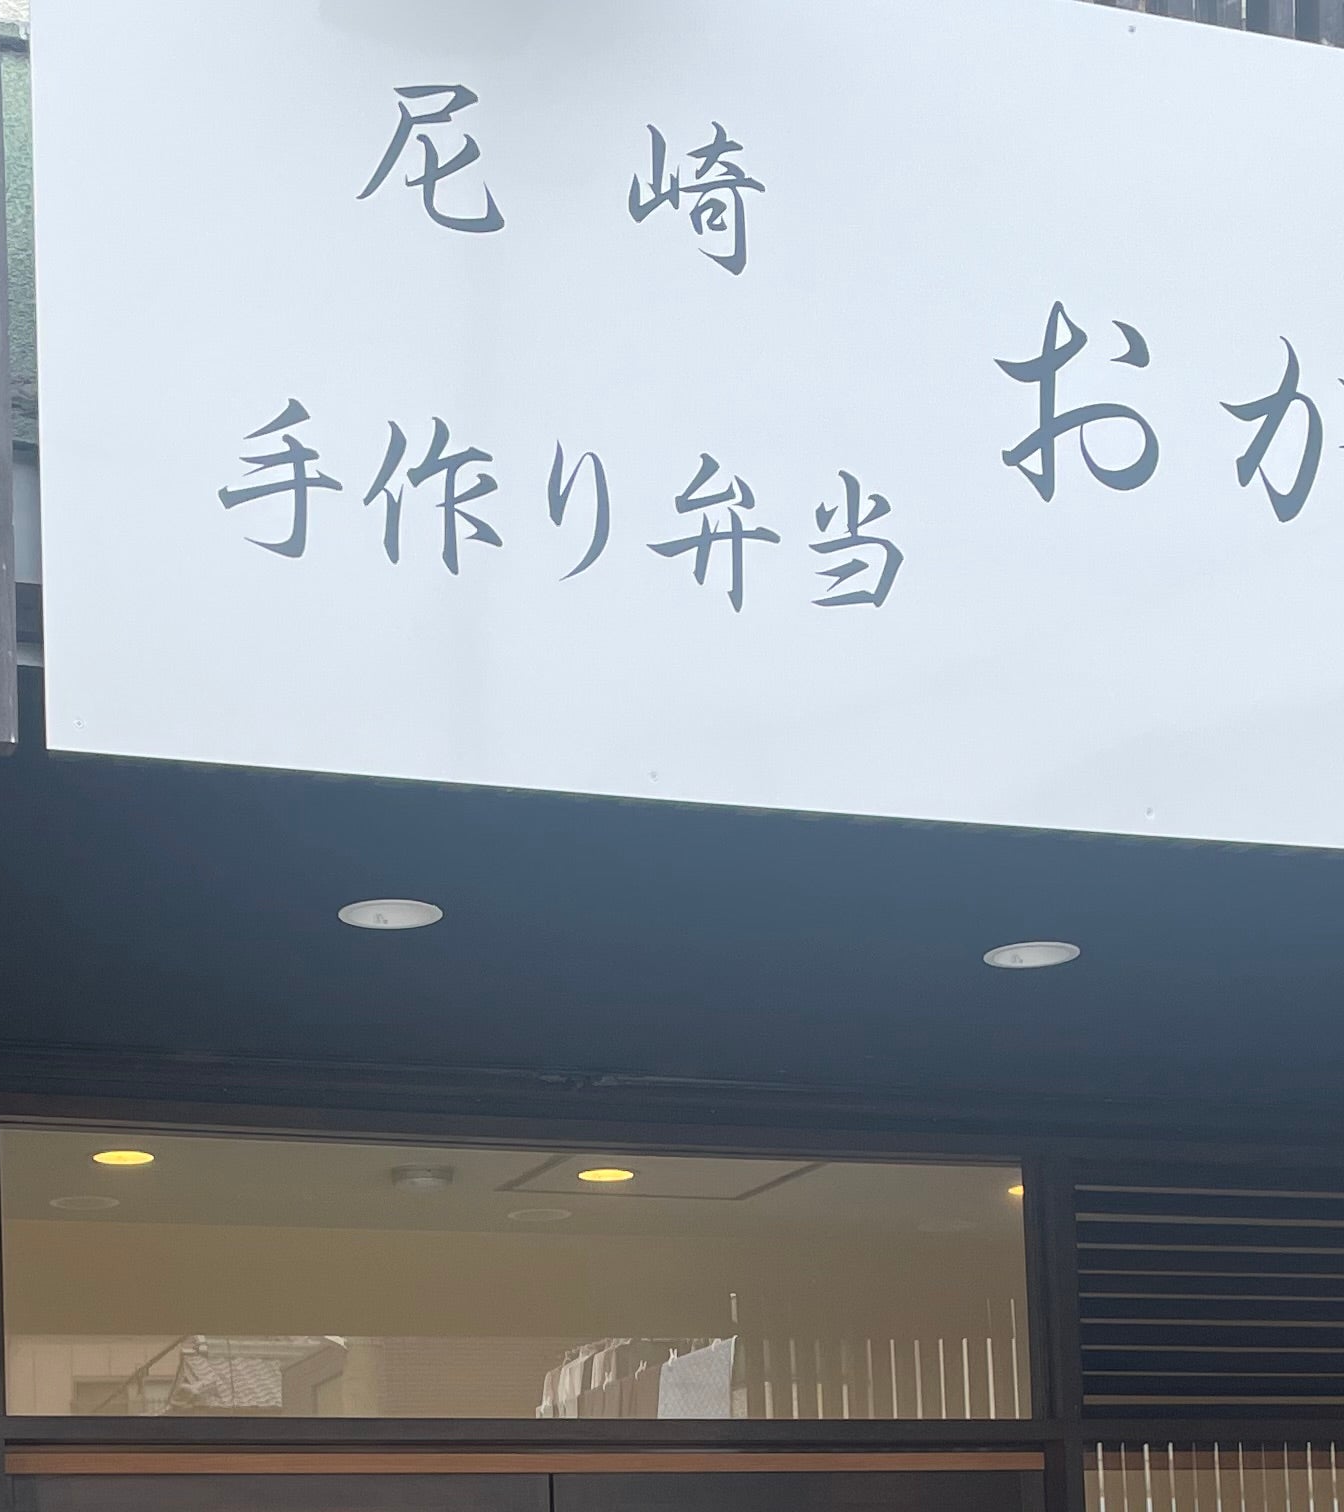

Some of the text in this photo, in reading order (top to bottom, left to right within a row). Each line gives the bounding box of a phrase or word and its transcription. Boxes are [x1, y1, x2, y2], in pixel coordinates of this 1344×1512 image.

[358, 82, 768, 276] 尼崎
[218, 398, 905, 614] 手作り弁当
